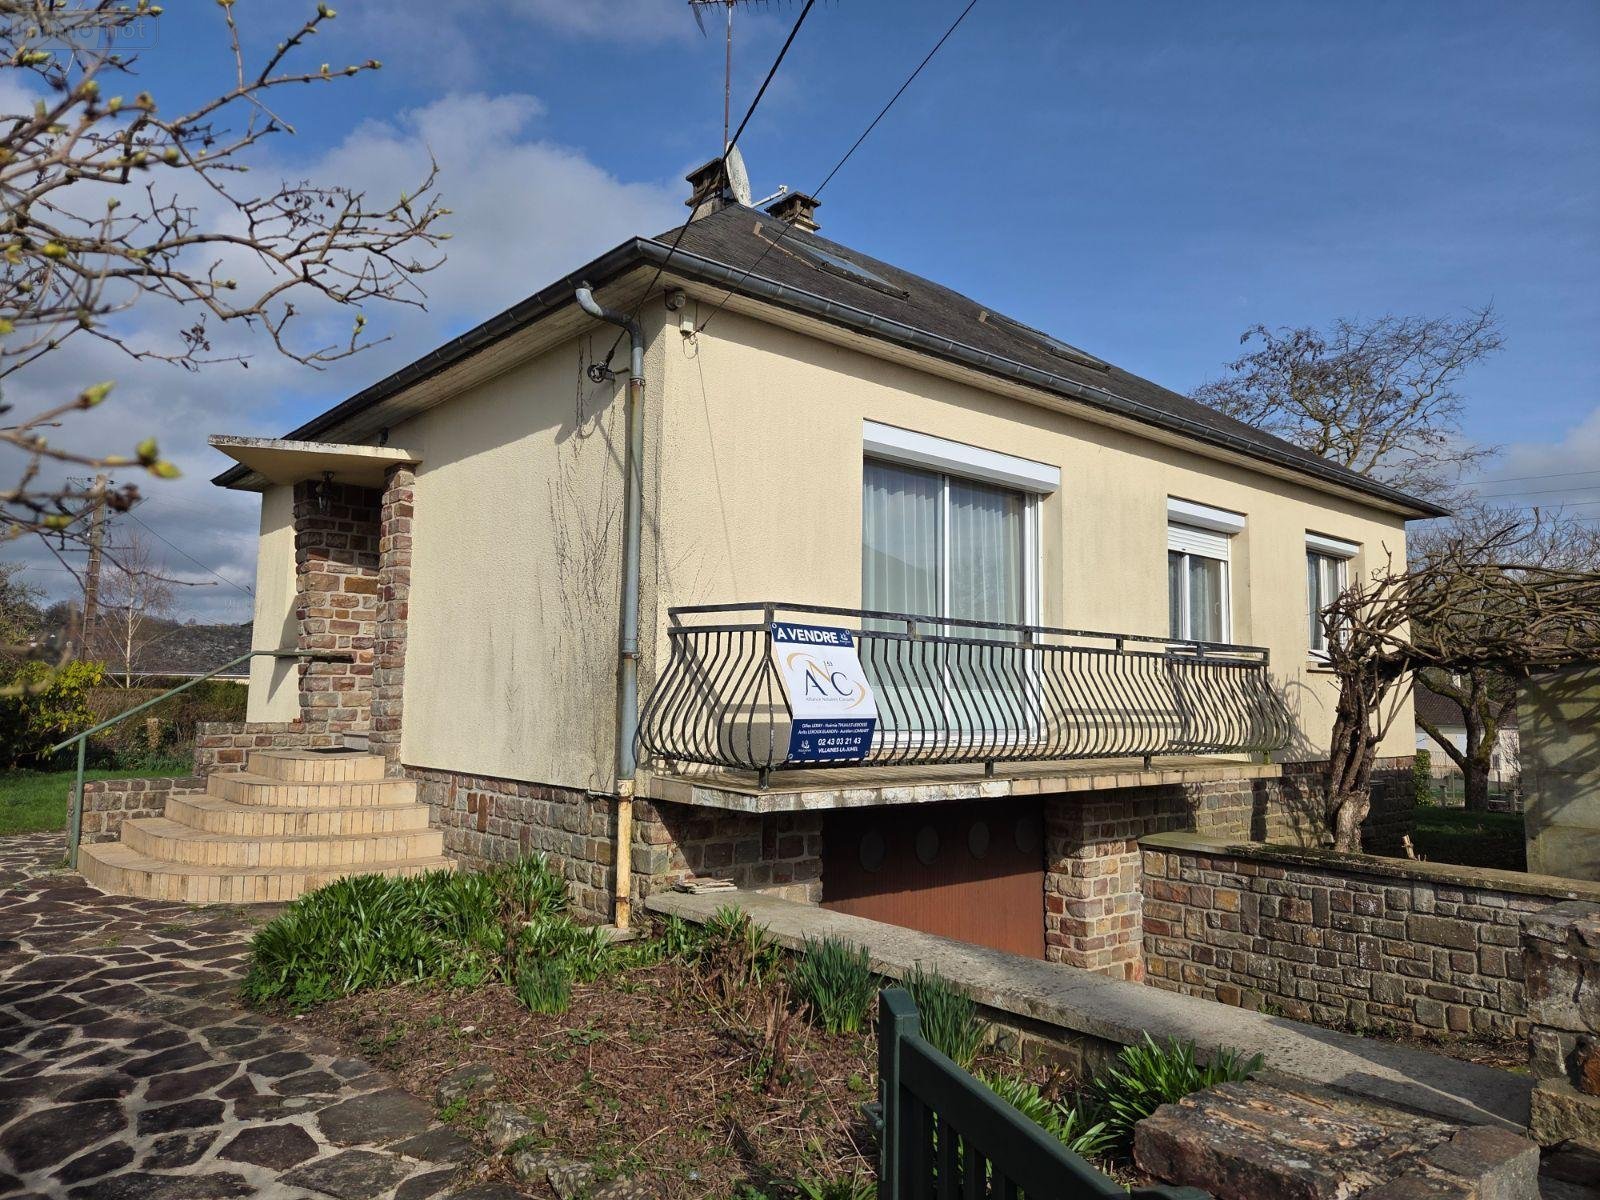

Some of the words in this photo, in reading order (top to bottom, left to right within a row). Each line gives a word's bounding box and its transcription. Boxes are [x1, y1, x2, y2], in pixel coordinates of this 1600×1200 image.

[777, 628, 788, 639] A
[787, 628, 839, 644] VENDRE
[836, 737, 844, 745] 03
[845, 737, 852, 745] 21
